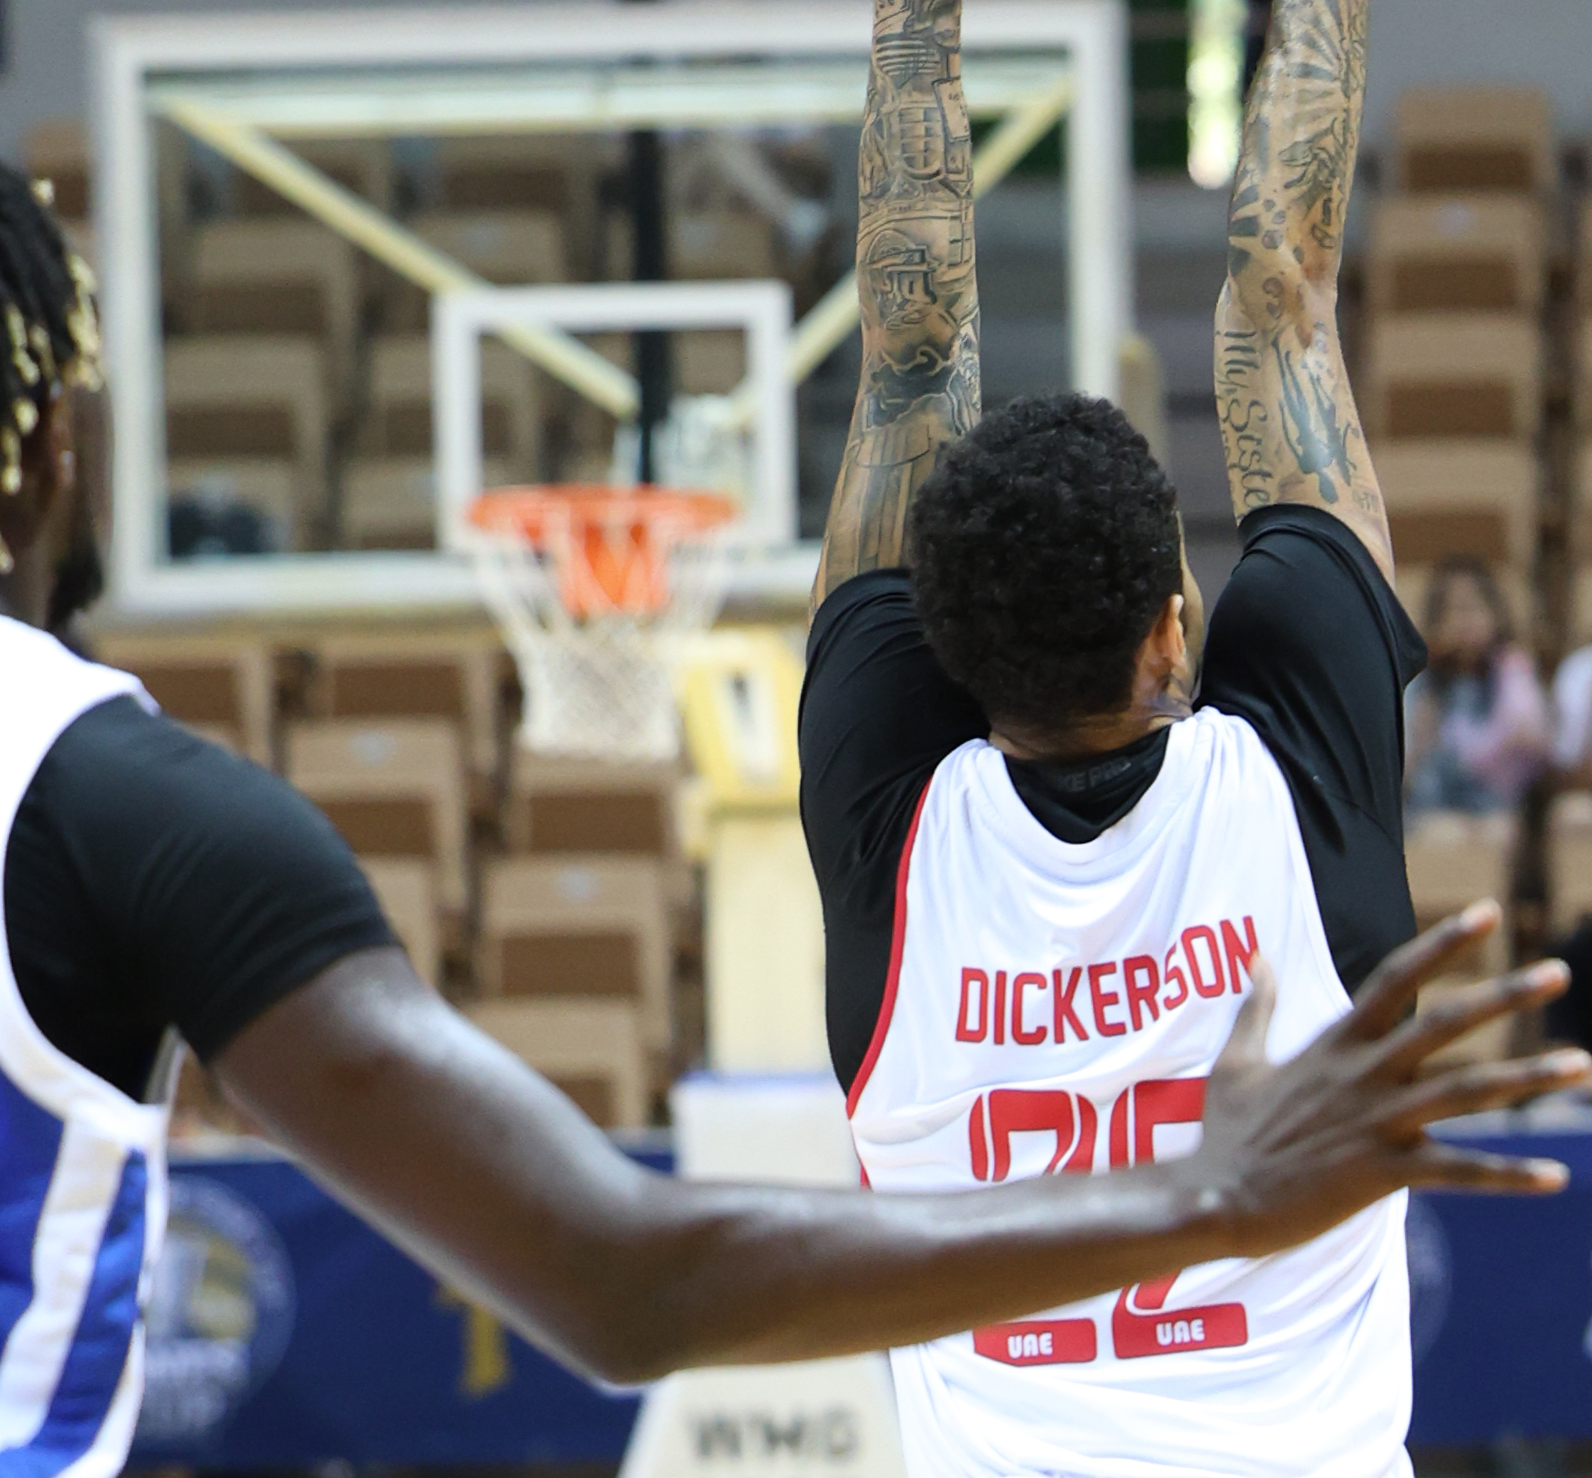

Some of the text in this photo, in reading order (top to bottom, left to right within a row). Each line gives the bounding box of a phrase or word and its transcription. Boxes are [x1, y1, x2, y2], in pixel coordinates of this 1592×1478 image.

[955, 914, 1260, 1046] DICKERSON
[1007, 1332, 1053, 1359] UAE
[1156, 1319, 1205, 1346] UAE
